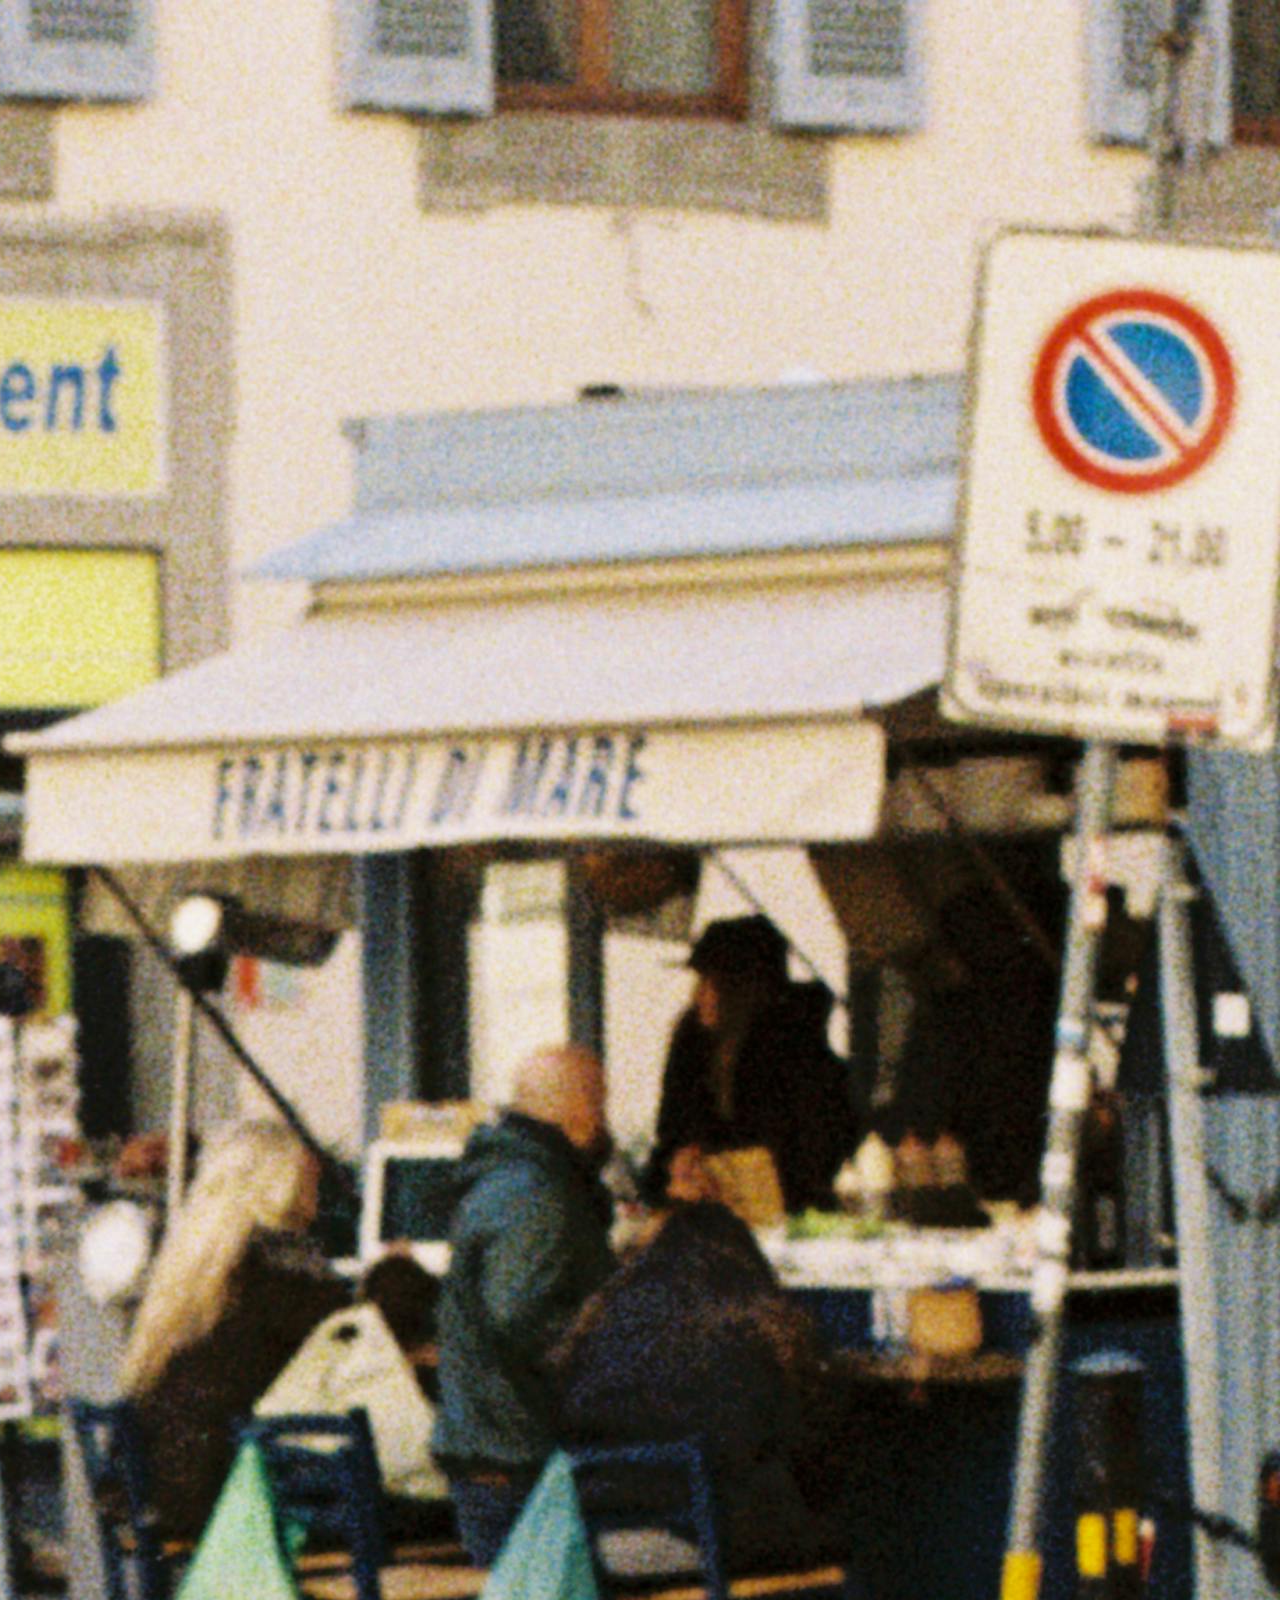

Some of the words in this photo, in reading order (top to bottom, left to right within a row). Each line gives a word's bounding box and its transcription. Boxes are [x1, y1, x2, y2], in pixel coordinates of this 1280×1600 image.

[211, 741, 420, 841] FRATELLI
[428, 738, 489, 826] DI
[497, 728, 649, 822] MARE
